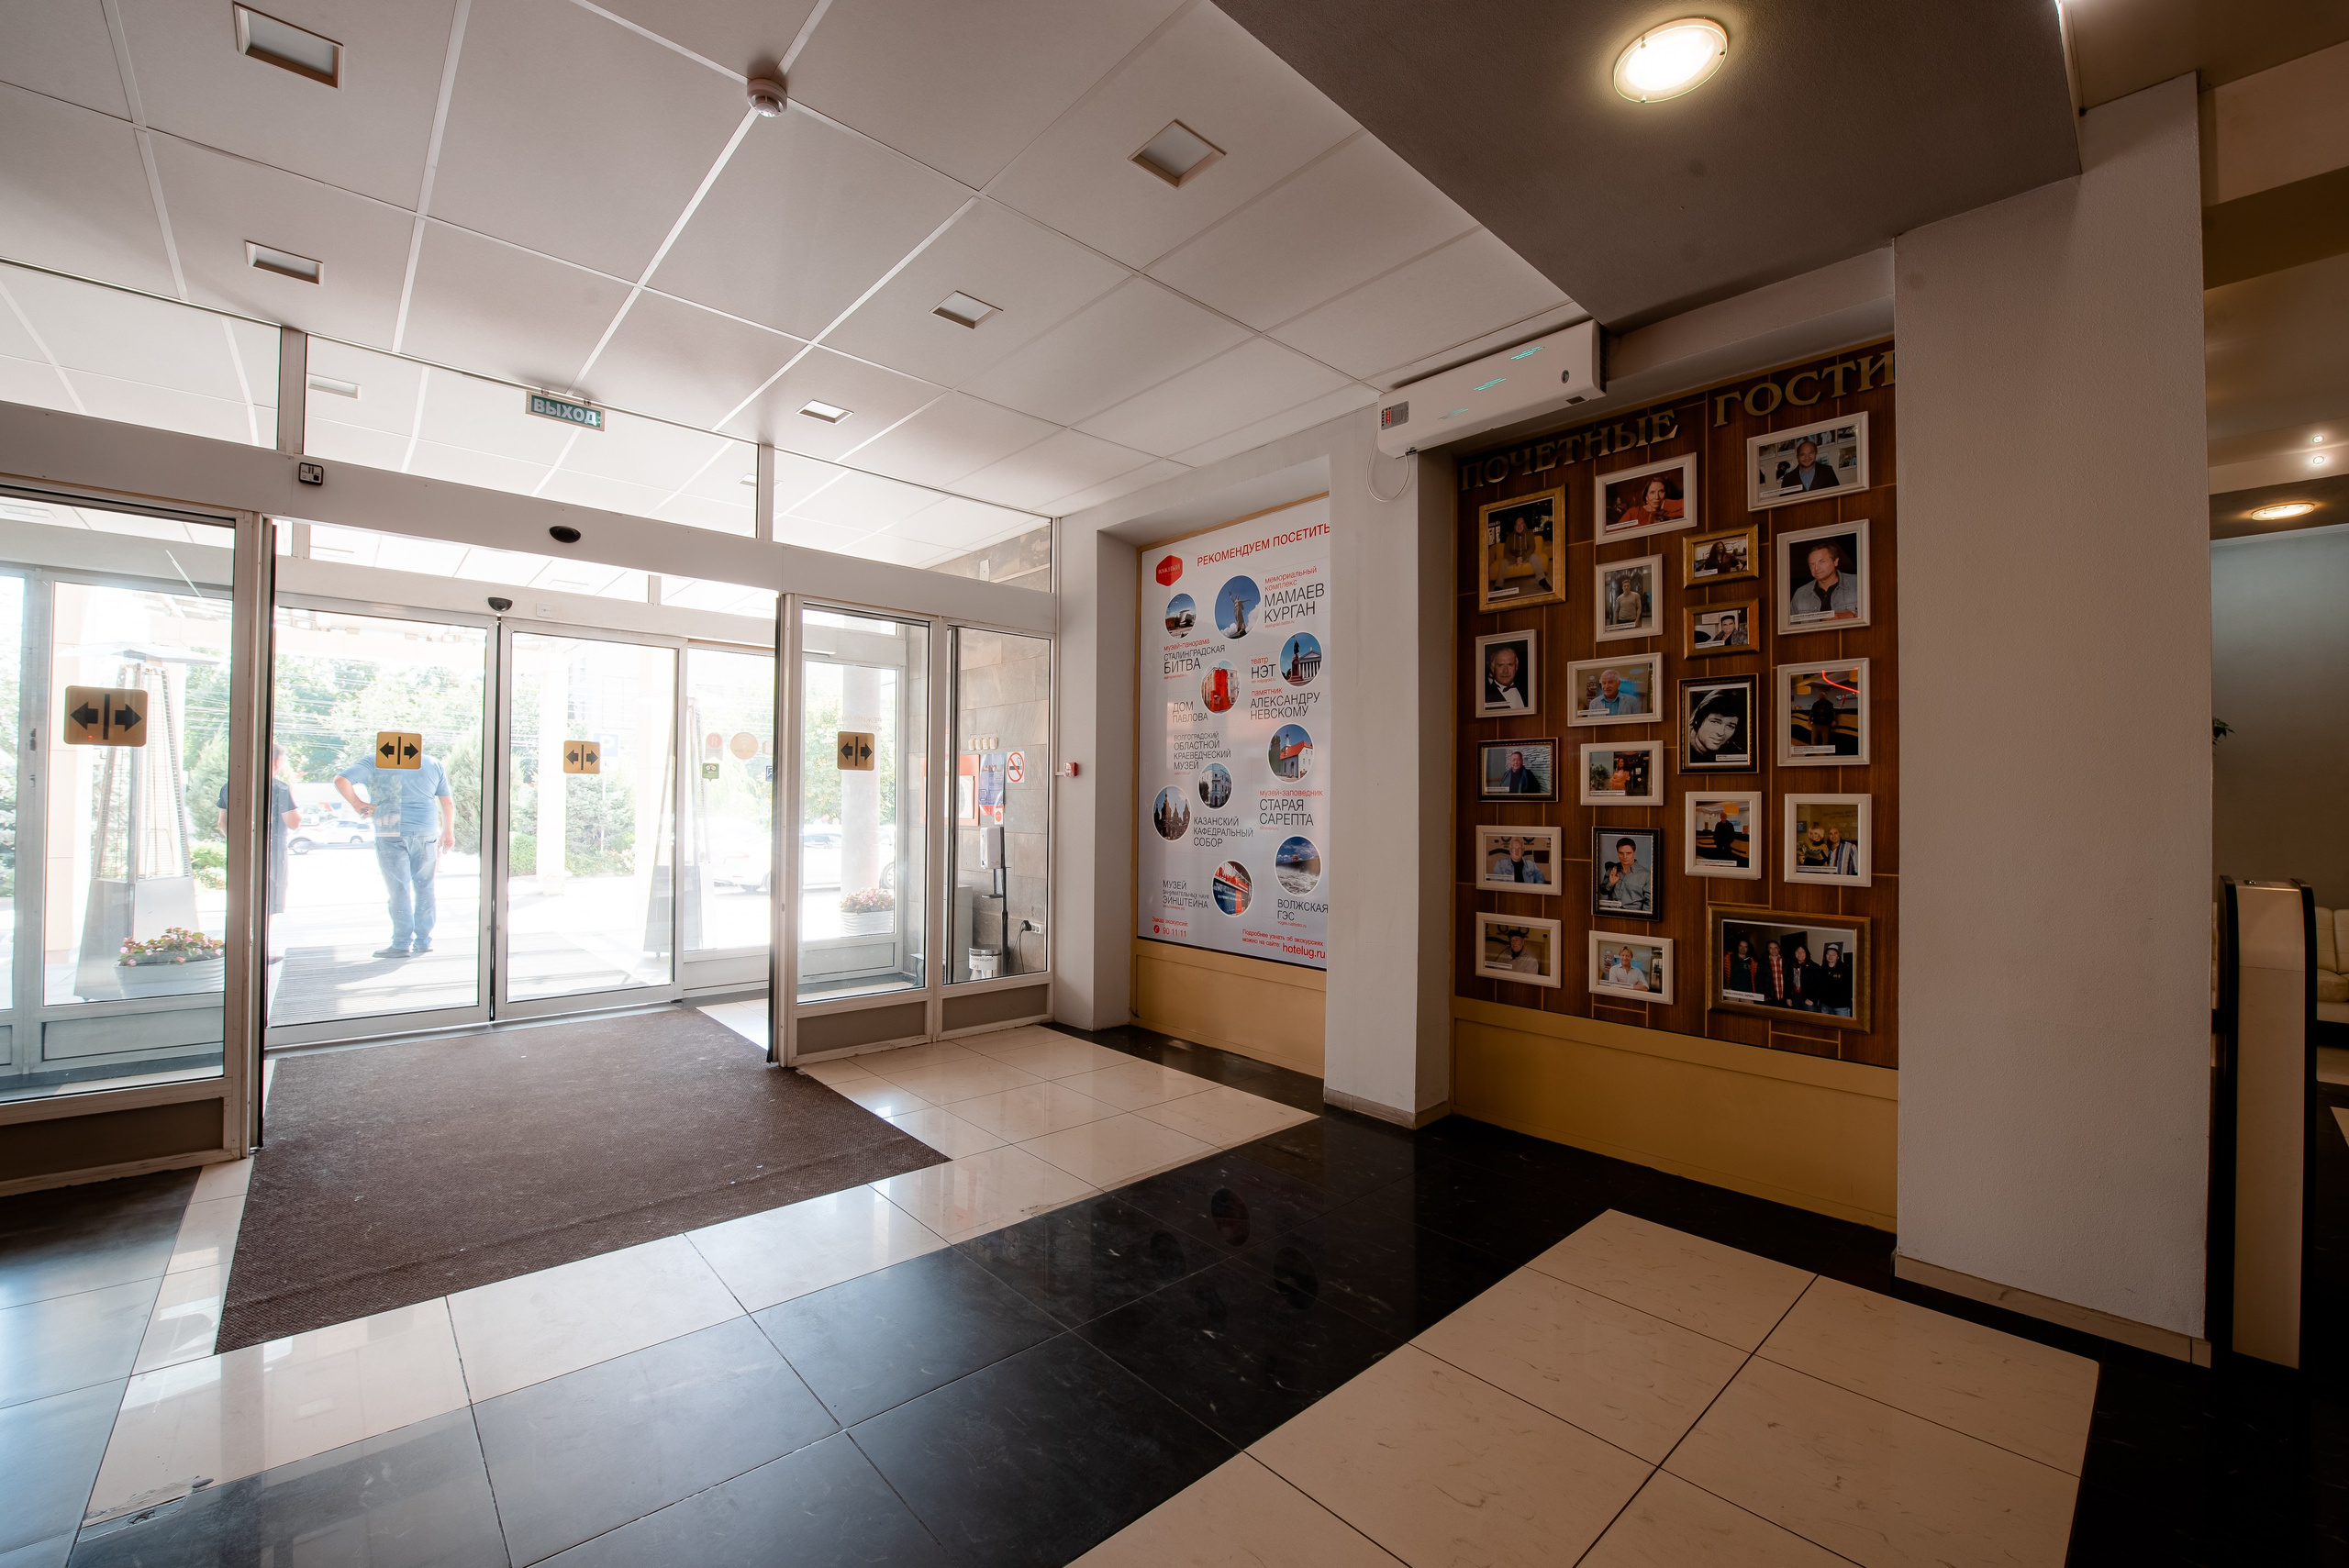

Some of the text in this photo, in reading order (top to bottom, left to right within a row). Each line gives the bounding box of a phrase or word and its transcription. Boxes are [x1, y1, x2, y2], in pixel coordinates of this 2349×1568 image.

[533, 397, 597, 426] ВЫХОД
[1462, 350, 1896, 491] ПОЧЕТНЫЕ ГОСТИ
[1197, 523, 1330, 567] РЕКОМЕНДУЕМ ПОСЕТИТЬ
[1264, 565, 1318, 584] мемориальный
[1264, 580, 1297, 592] комплекс
[1264, 583, 1325, 608] МАМАЕВ
[1264, 601, 1316, 623] КУРГАН
[1163, 645, 1226, 662] СТАЛИНГРАДСКАЯ
[1163, 658, 1201, 674] БИТВА
[1250, 657, 1269, 665] театр
[1251, 664, 1276, 680] НЭТ
[1251, 688, 1283, 697] памятник
[1250, 692, 1321, 709] АЛЕКСАНДРУ
[1173, 701, 1194, 715] ДОМ
[1250, 706, 1309, 721] НЕВСКОМУ
[1173, 712, 1208, 724] ПАВЛОВА
[1174, 739, 1220, 751] ОБЛАСТНОЙ
[1174, 749, 1231, 761] КРАЕВЕДЧЕСКИЙ
[1174, 760, 1199, 771] МУЗЕЙ
[1259, 789, 1324, 798] музей-заповедник
[1259, 798, 1304, 811] СТАРАЯ
[1193, 816, 1240, 827] КАЗАНСКИЙ
[1259, 812, 1315, 826] САРЕПТА
[1193, 828, 1253, 838] КАФЕДРАЛЬНЫЙ
[1193, 837, 1223, 848] СОБОР
[1163, 880, 1187, 890] МУЗЕЙ
[1163, 895, 1209, 909] ЭЙНШТЕЙНА
[1277, 898, 1329, 914] ВОЛЖСКАЯ
[1277, 910, 1295, 921] ГЭС
[1163, 927, 1170, 935] 90
[1180, 929, 1186, 938] 11
[1242, 929, 1269, 939] Подробнее
[1282, 942, 1327, 960] hotelug.ru
